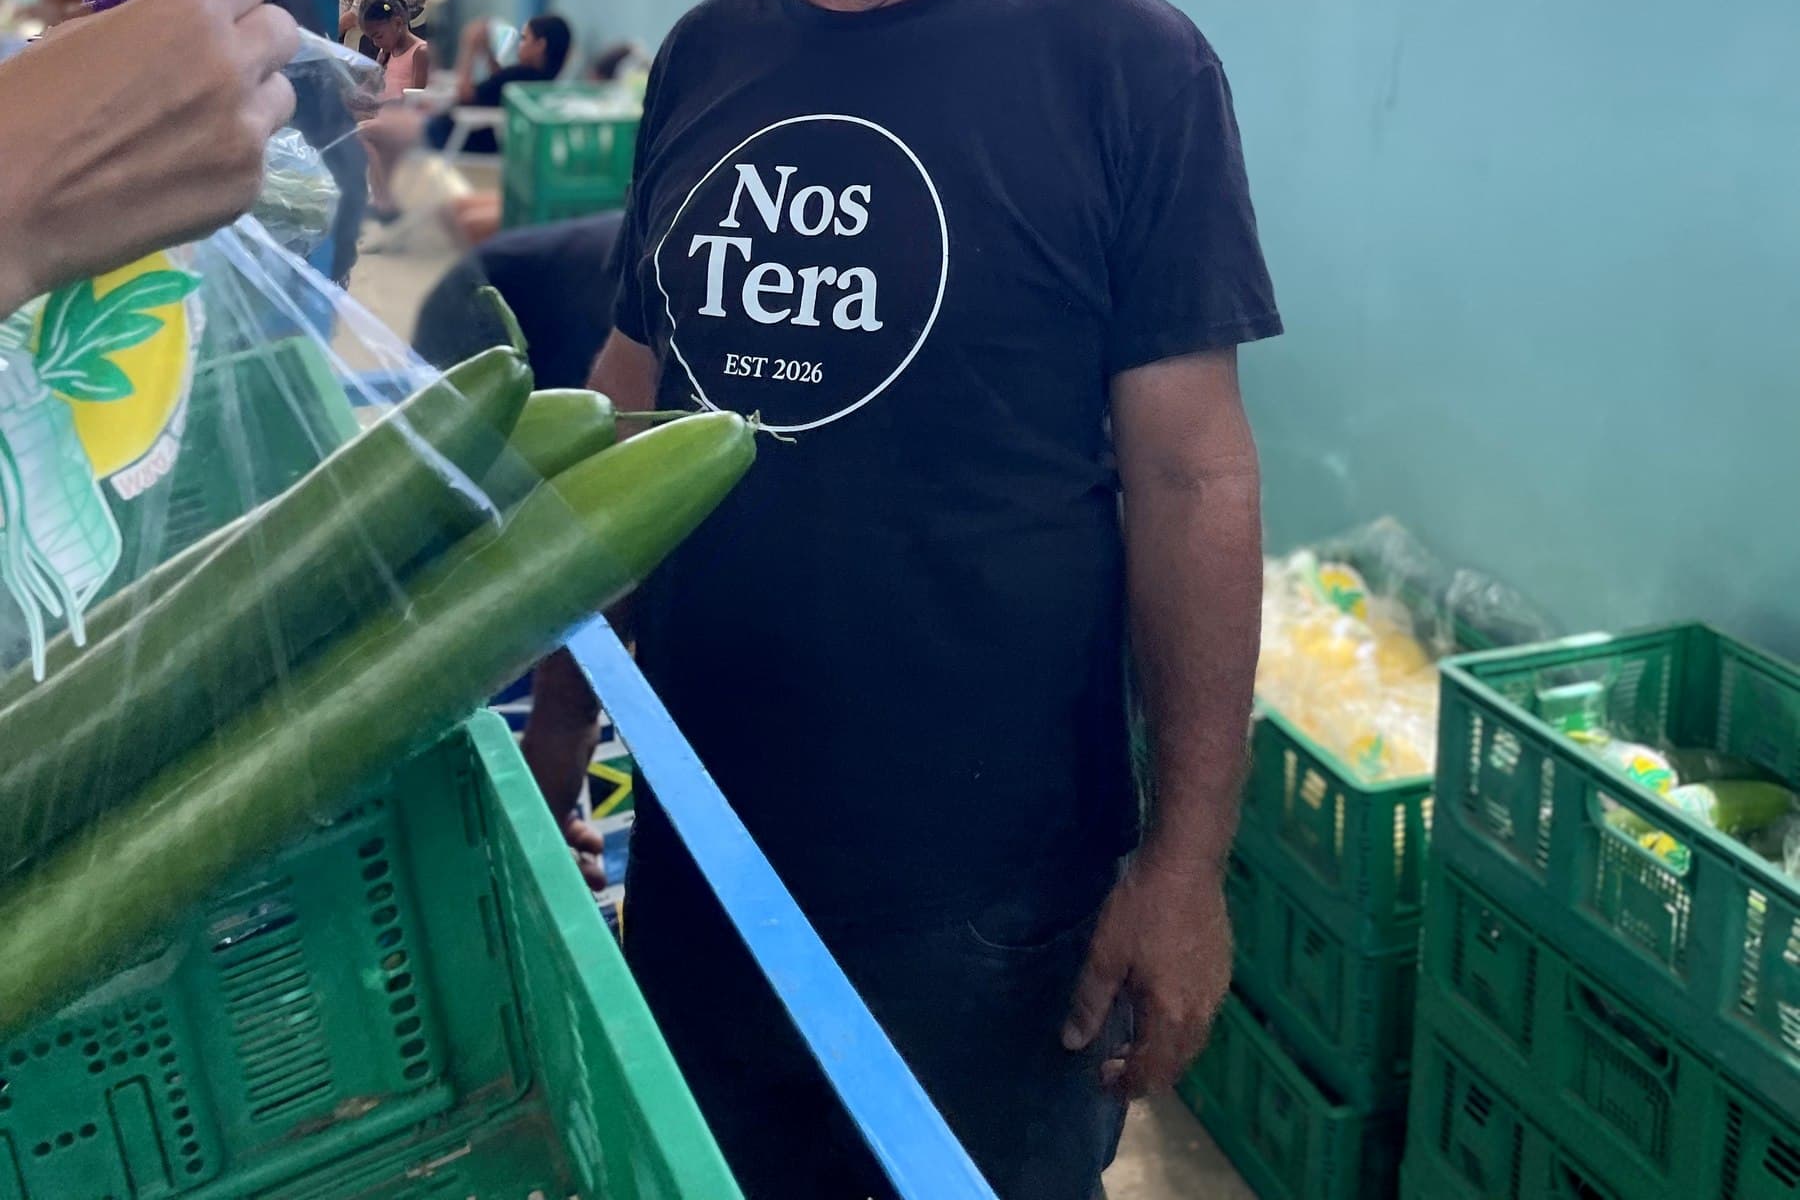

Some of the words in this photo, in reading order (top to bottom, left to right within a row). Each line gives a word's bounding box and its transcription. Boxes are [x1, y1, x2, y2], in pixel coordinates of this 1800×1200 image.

[718, 163, 871, 237] Nos
[687, 233, 884, 332] Tera
[723, 353, 768, 378] EST
[772, 358, 824, 384] 2026
